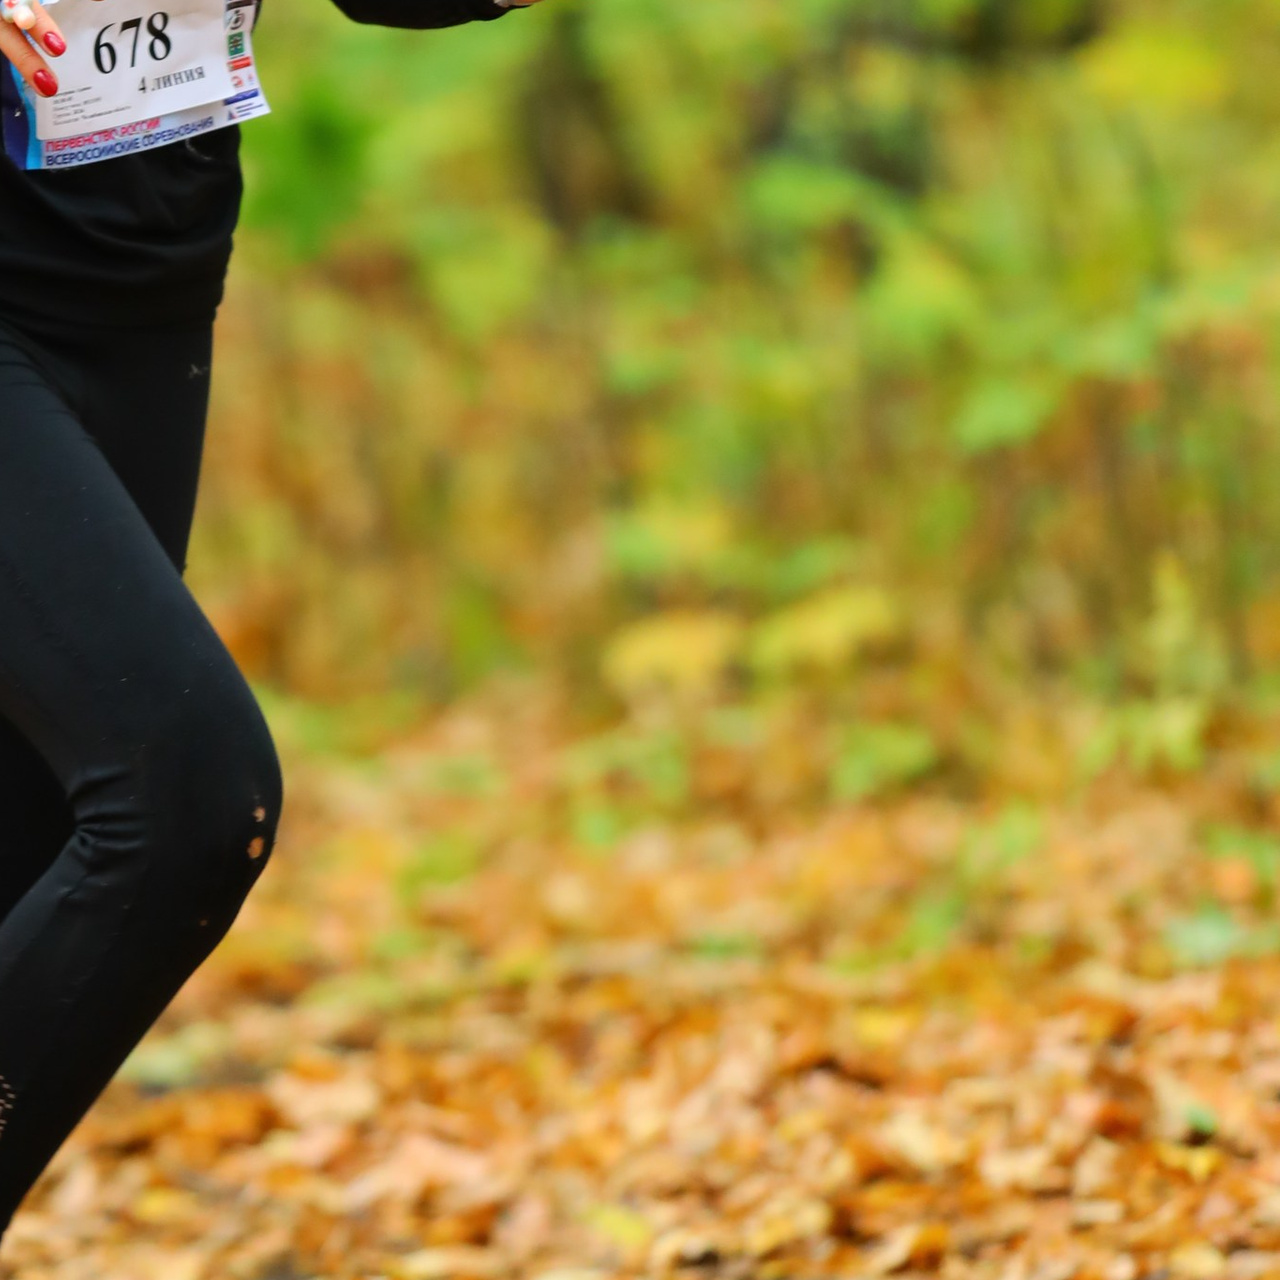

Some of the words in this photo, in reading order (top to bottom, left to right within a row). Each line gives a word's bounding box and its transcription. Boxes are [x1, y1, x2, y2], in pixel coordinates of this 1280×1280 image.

[94, 11, 172, 74] 678
[138, 76, 147, 94] 4
[45, 128, 117, 152] ПЕРВЕНСТВО
[121, 117, 161, 136] РОССИИ
[142, 116, 214, 149] СОРЕВНОВАНИЯ
